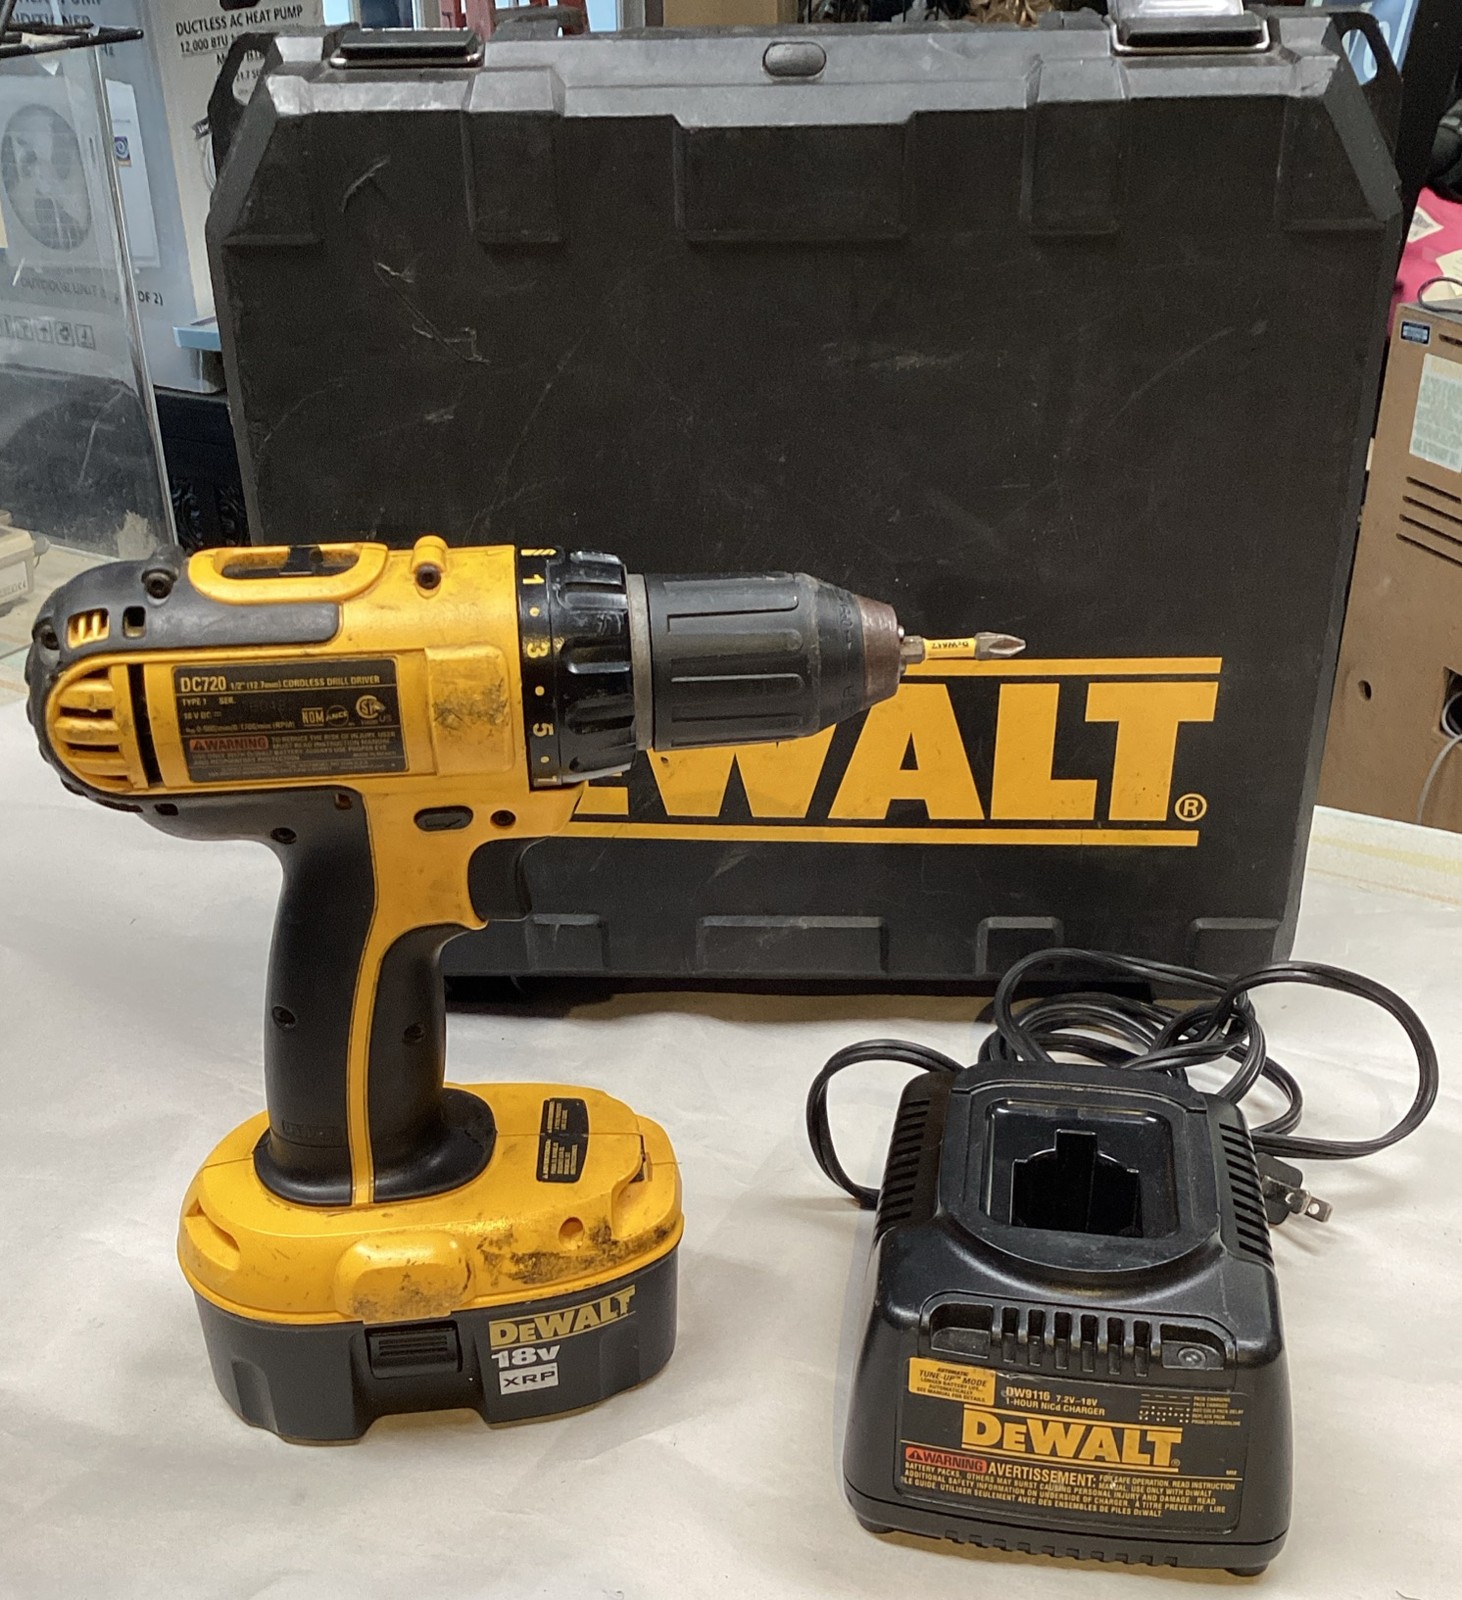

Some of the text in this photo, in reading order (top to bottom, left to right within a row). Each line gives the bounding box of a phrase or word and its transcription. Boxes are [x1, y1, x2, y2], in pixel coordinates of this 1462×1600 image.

[176, 4, 303, 36] DUCTLESS AC HEAT PUMP
[211, 35, 229, 48] BTU
[527, 641, 549, 659] 3
[180, 676, 227, 692] DC720
[282, 677, 325, 688] CORDLESS
[326, 676, 349, 686] DRILL
[350, 675, 380, 685] DRIVER
[182, 698, 201, 706] TYPE
[302, 709, 325, 724] NOM
[533, 722, 554, 737] 5
[205, 737, 267, 752] WARNING
[576, 682, 1219, 821] WALT
[490, 1288, 636, 1348] DEWALT
[491, 1345, 561, 1369] 18V
[503, 1370, 556, 1388] XRP
[942, 1381, 968, 1390] BATTERY
[963, 1378, 988, 1388] MODE
[927, 1388, 951, 1398] MANUAL
[928, 1384, 974, 1395] AUTOMATICALLY
[1005, 1386, 1051, 1401] DW9116
[1005, 1397, 1039, 1410] 1-HOUR
[1062, 1403, 1106, 1417] CHARGER
[963, 1411, 1183, 1467] DEWALT
[923, 1451, 984, 1473] WARNING
[988, 1461, 1097, 1487] AVERTISSEMENT:
[1099, 1474, 1113, 1482] FOR
[1114, 1475, 1131, 1484] SAFE
[1172, 1480, 1190, 1489] READ
[1191, 1481, 1236, 1491] INSTRUCTION
[904, 1461, 935, 1474] BATTERY
[966, 1470, 995, 1484] OTHERS
[996, 1475, 1012, 1485] MAY
[1014, 1479, 1038, 1489] BURST
[1039, 1482, 1072, 1493] CAUSING
[1073, 1487, 1111, 1499] PERSONAL
[1113, 1491, 1139, 1501] INJURY
[1141, 1494, 1158, 1502] AND
[904, 1470, 946, 1485] ADDITIONAL
[948, 1476, 975, 1488] SAFETY
[976, 1481, 1026, 1496] INFORMATION
[1027, 1489, 1038, 1497] ON
[1039, 1490, 1082, 1502] UNDERSIDE
[1083, 1495, 1093, 1503] OF
[1142, 1501, 1163, 1510] TITRE
[1209, 1505, 1226, 1514] LIRE
[940, 1483, 972, 1496] UTILISER
[974, 1488, 1016, 1502] SEULEMENT
[1017, 1495, 1037, 1505] AVEC
[1038, 1498, 1053, 1507] DES
[1054, 1499, 1098, 1512] ENSEMBLES
[1099, 1505, 1109, 1513] DE
[1110, 1506, 1132, 1516] PILES
[1131, 1486, 1145, 1494] USE
[1146, 1487, 1165, 1496] ONLY
[1165, 1488, 1184, 1497] WITH
